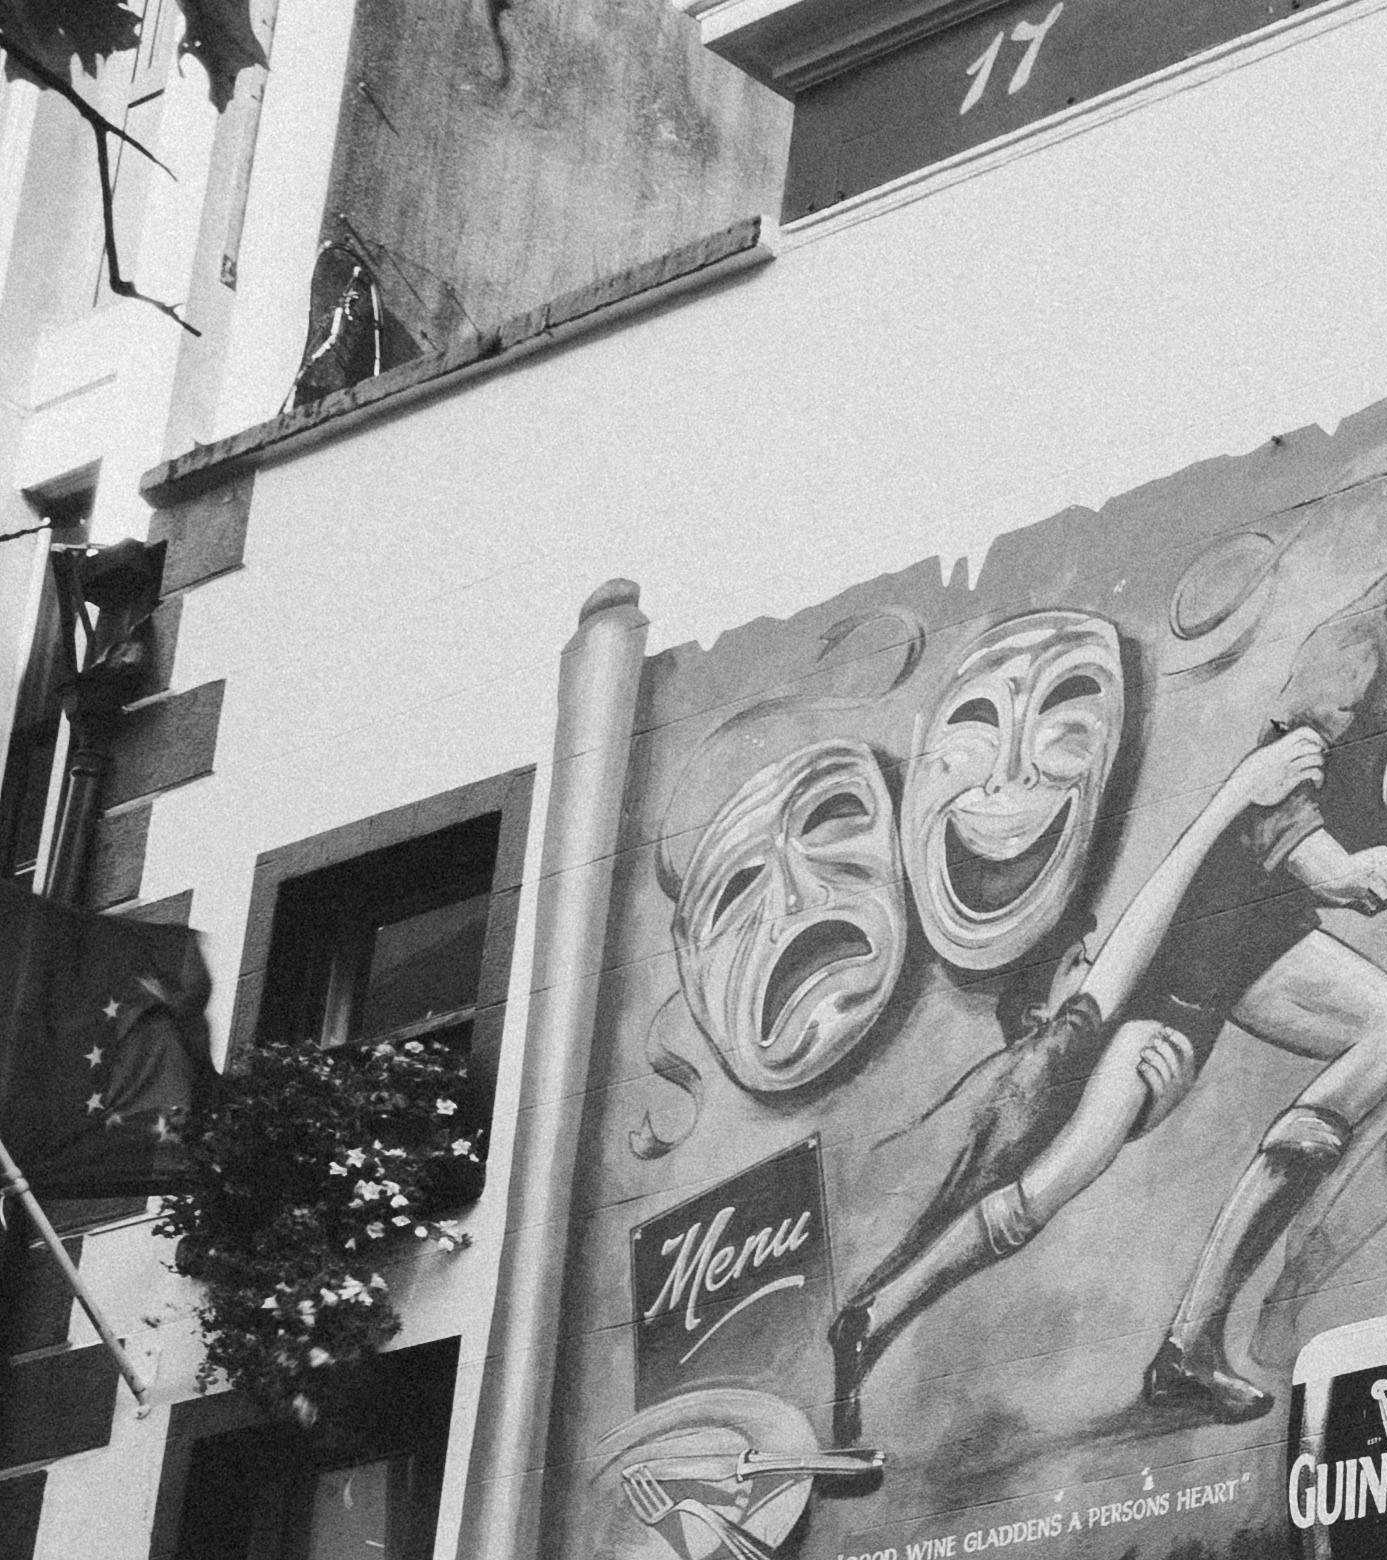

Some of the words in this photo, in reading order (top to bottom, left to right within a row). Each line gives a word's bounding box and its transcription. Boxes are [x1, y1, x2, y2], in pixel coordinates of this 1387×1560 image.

[960, 1, 1064, 115] 17
[643, 1206, 811, 1331] Menu
[963, 1513, 1063, 1554] GLADDENS
[1069, 1512, 1082, 1533] A
[1088, 1492, 1170, 1528] PERSONS
[1176, 1472, 1251, 1512] HEART"
